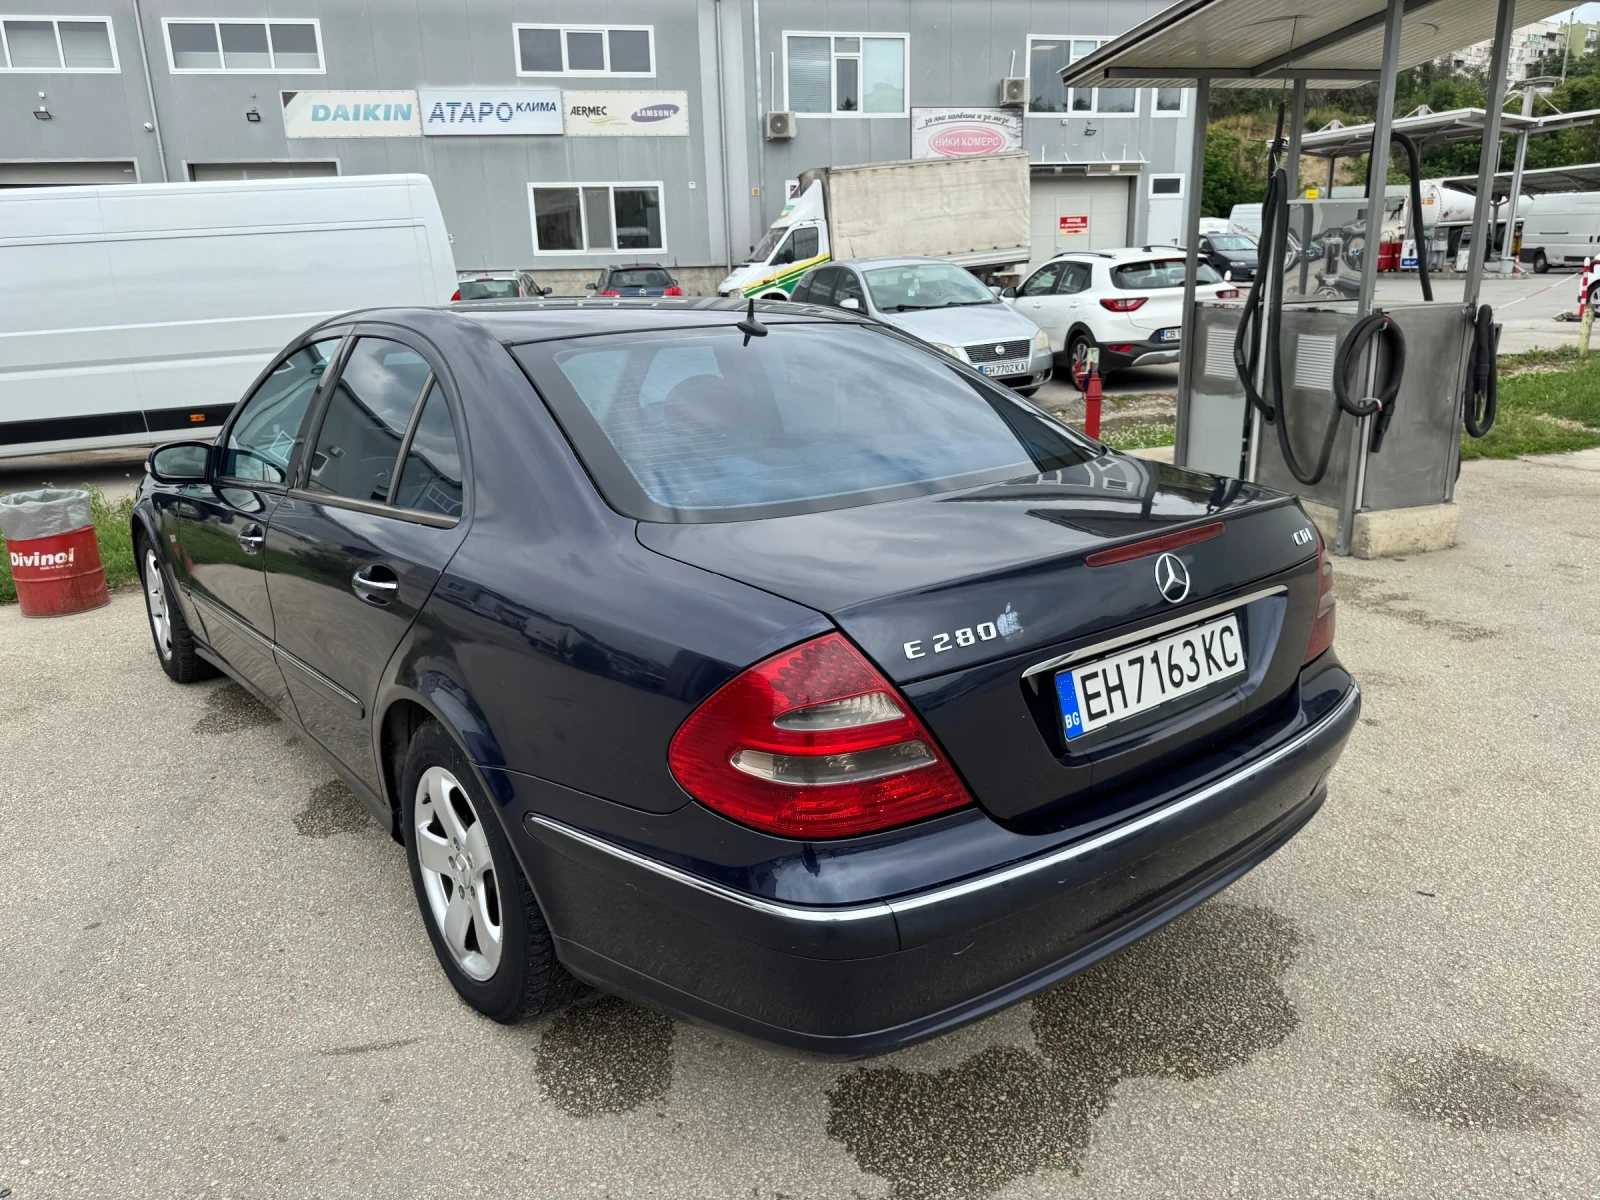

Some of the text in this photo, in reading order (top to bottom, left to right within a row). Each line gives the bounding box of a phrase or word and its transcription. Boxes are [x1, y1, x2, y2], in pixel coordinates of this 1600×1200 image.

[311, 103, 412, 122] DAIKIN
[428, 102, 556, 123] АТАРО КЛИМА
[570, 106, 607, 117] AERMEC
[636, 109, 675, 117] SAMSUNG
[935, 137, 999, 147] НИКИ КОМЕРС
[1292, 527, 1313, 546] CDI
[10, 547, 74, 566] Divinol
[903, 622, 997, 659] E 280
[1064, 710, 1081, 730] BG
